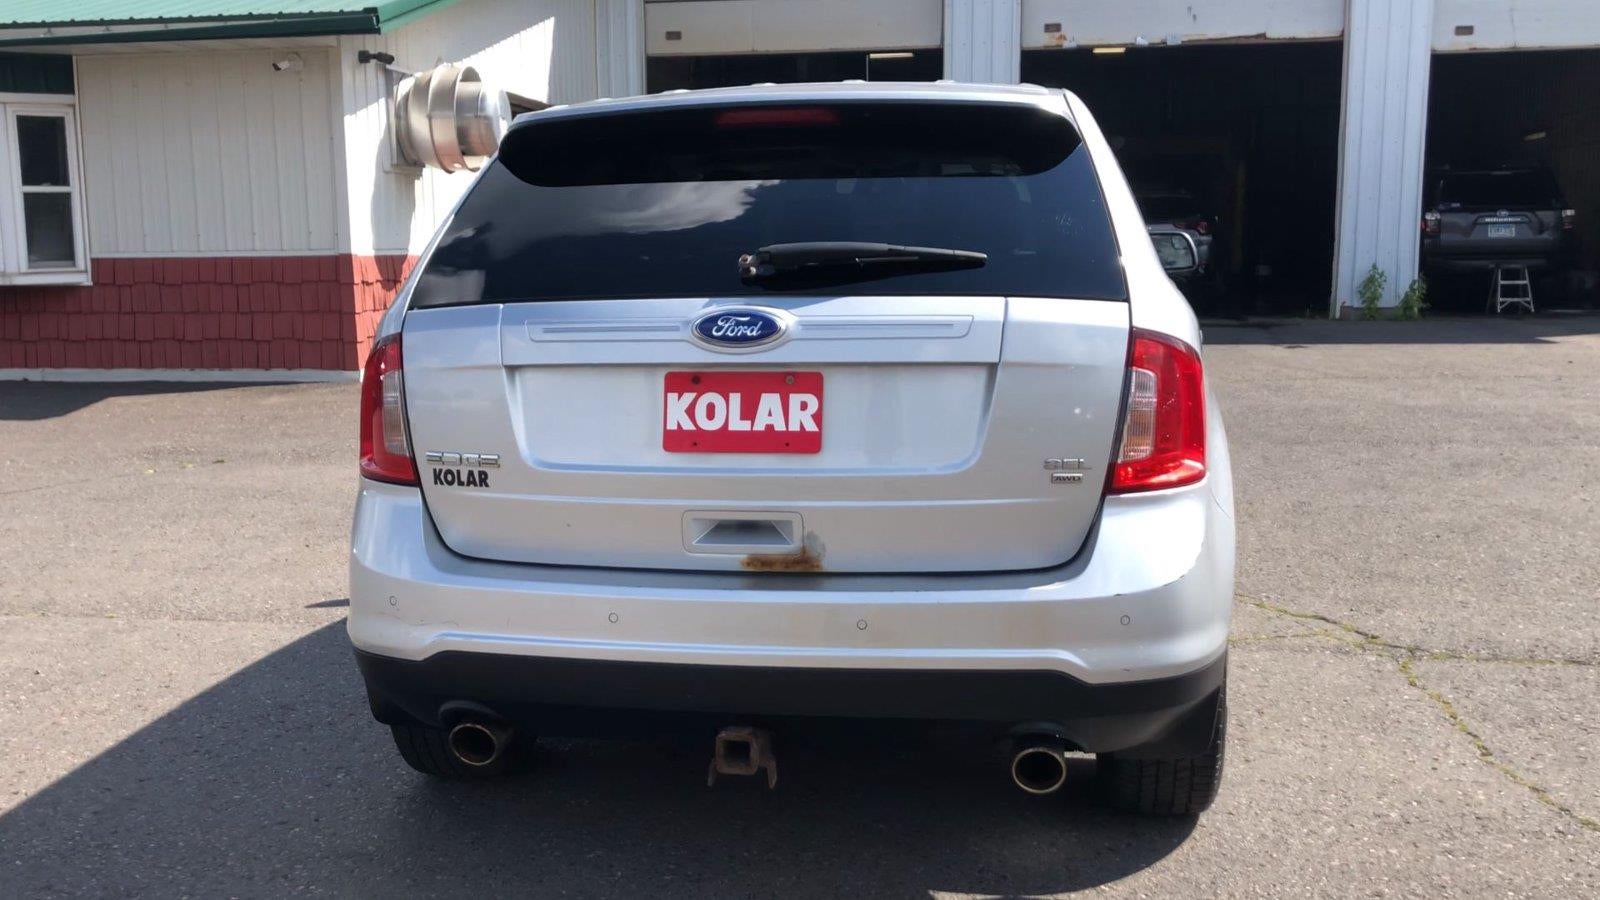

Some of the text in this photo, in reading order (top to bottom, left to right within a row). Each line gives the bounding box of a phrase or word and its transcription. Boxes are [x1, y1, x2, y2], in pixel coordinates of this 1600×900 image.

[712, 315, 763, 337] Ford
[666, 391, 820, 432] KOLAR
[432, 467, 490, 488] KOLAR
